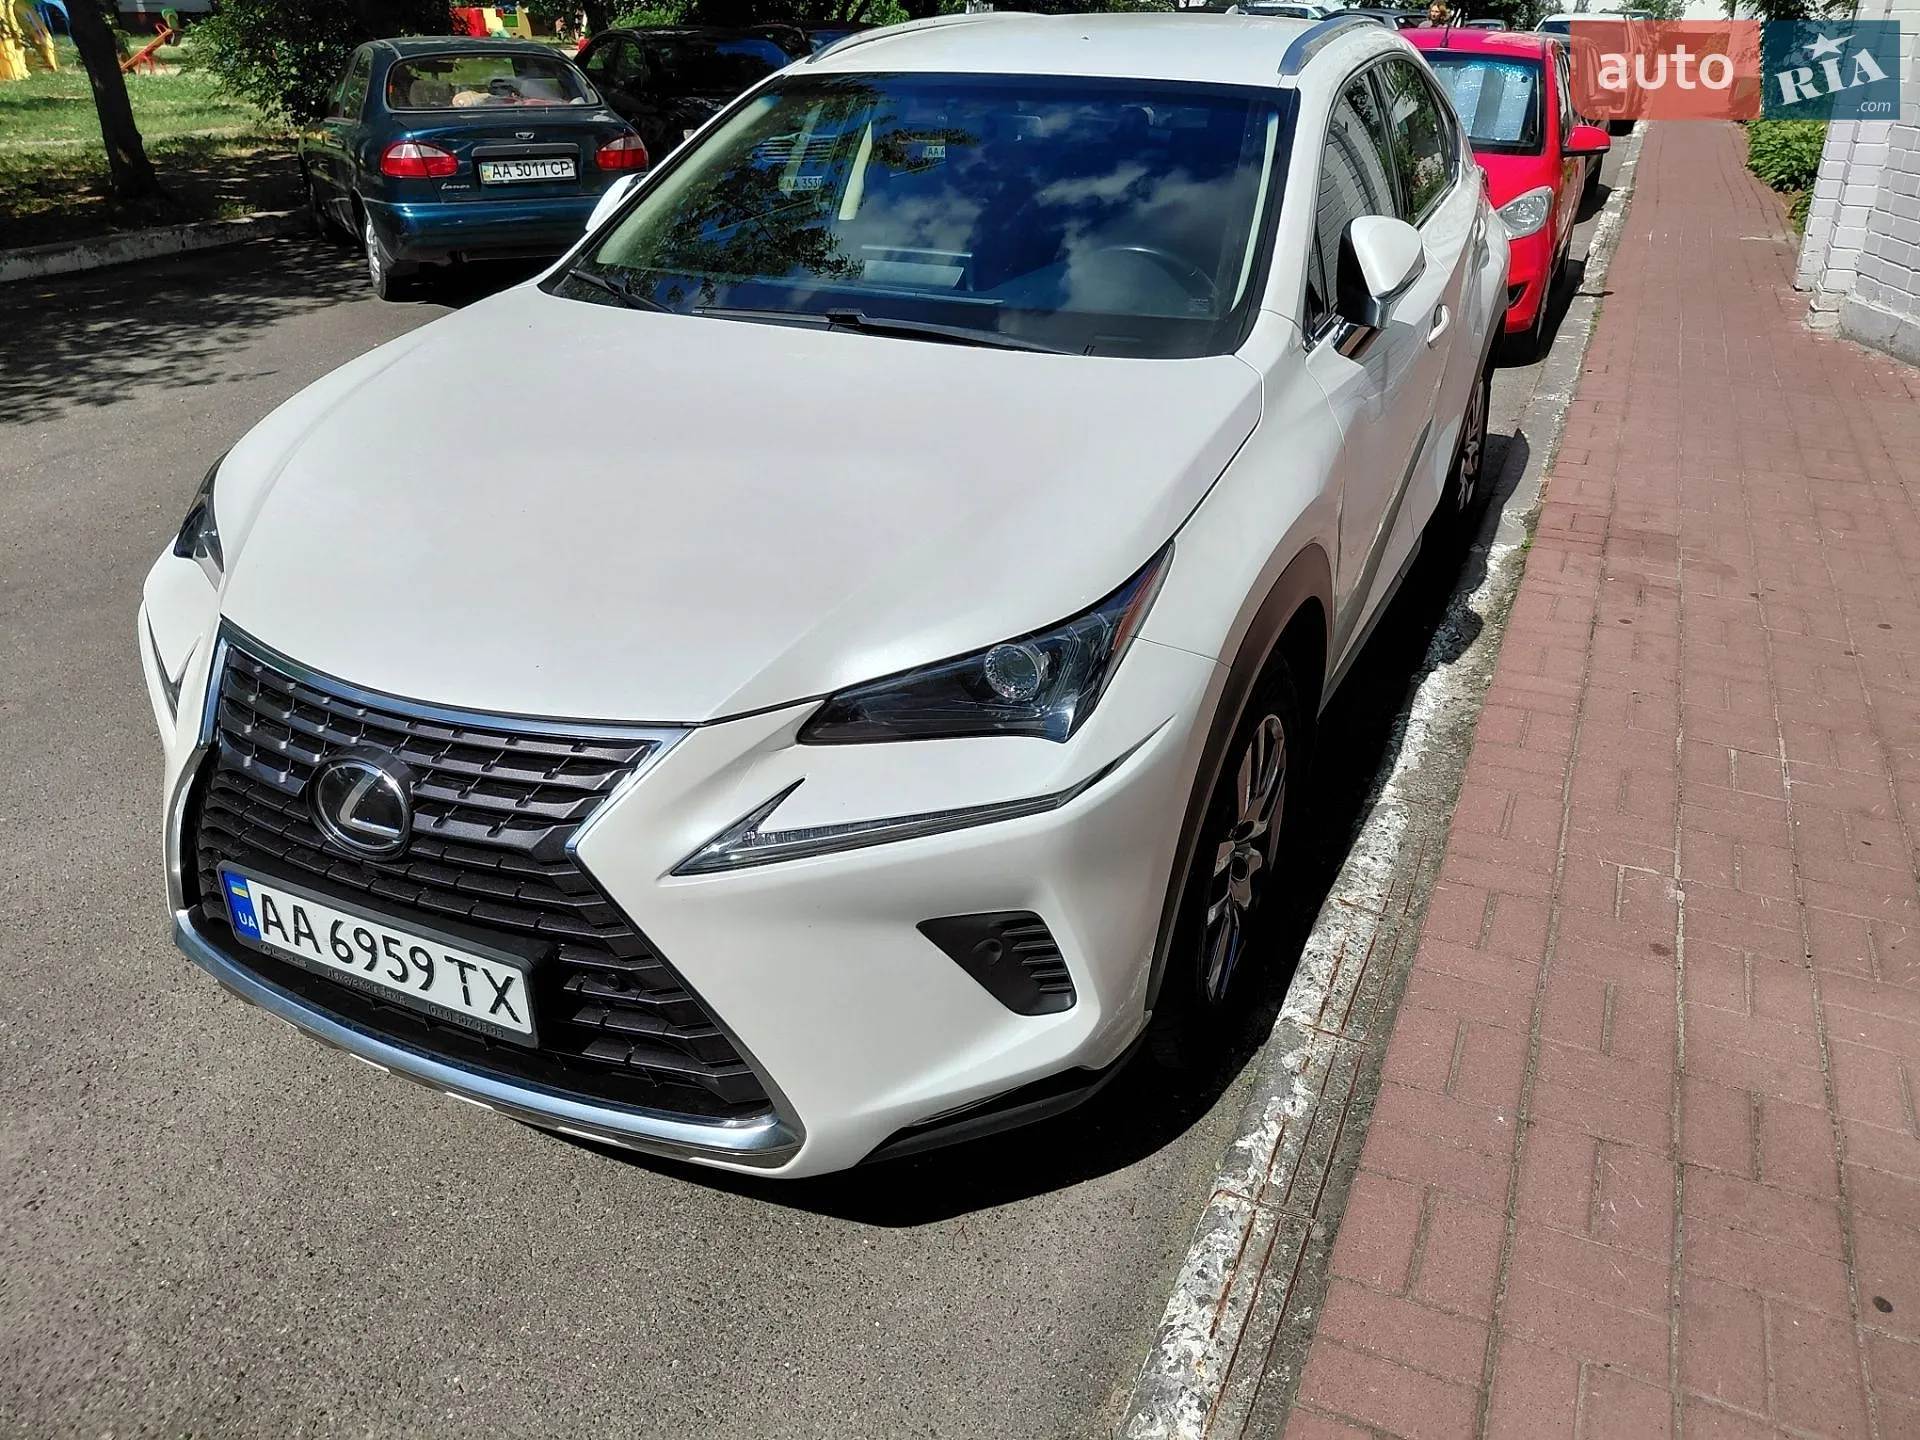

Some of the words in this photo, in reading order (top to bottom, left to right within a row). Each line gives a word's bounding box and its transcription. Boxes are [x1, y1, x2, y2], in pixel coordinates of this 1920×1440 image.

[493, 164, 512, 178] AA
[516, 162, 547, 177] 5011
[551, 161, 570, 175] CP
[238, 911, 258, 930] UA
[260, 892, 323, 955] AA
[329, 919, 435, 991] 6959
[445, 955, 522, 1024] TX
